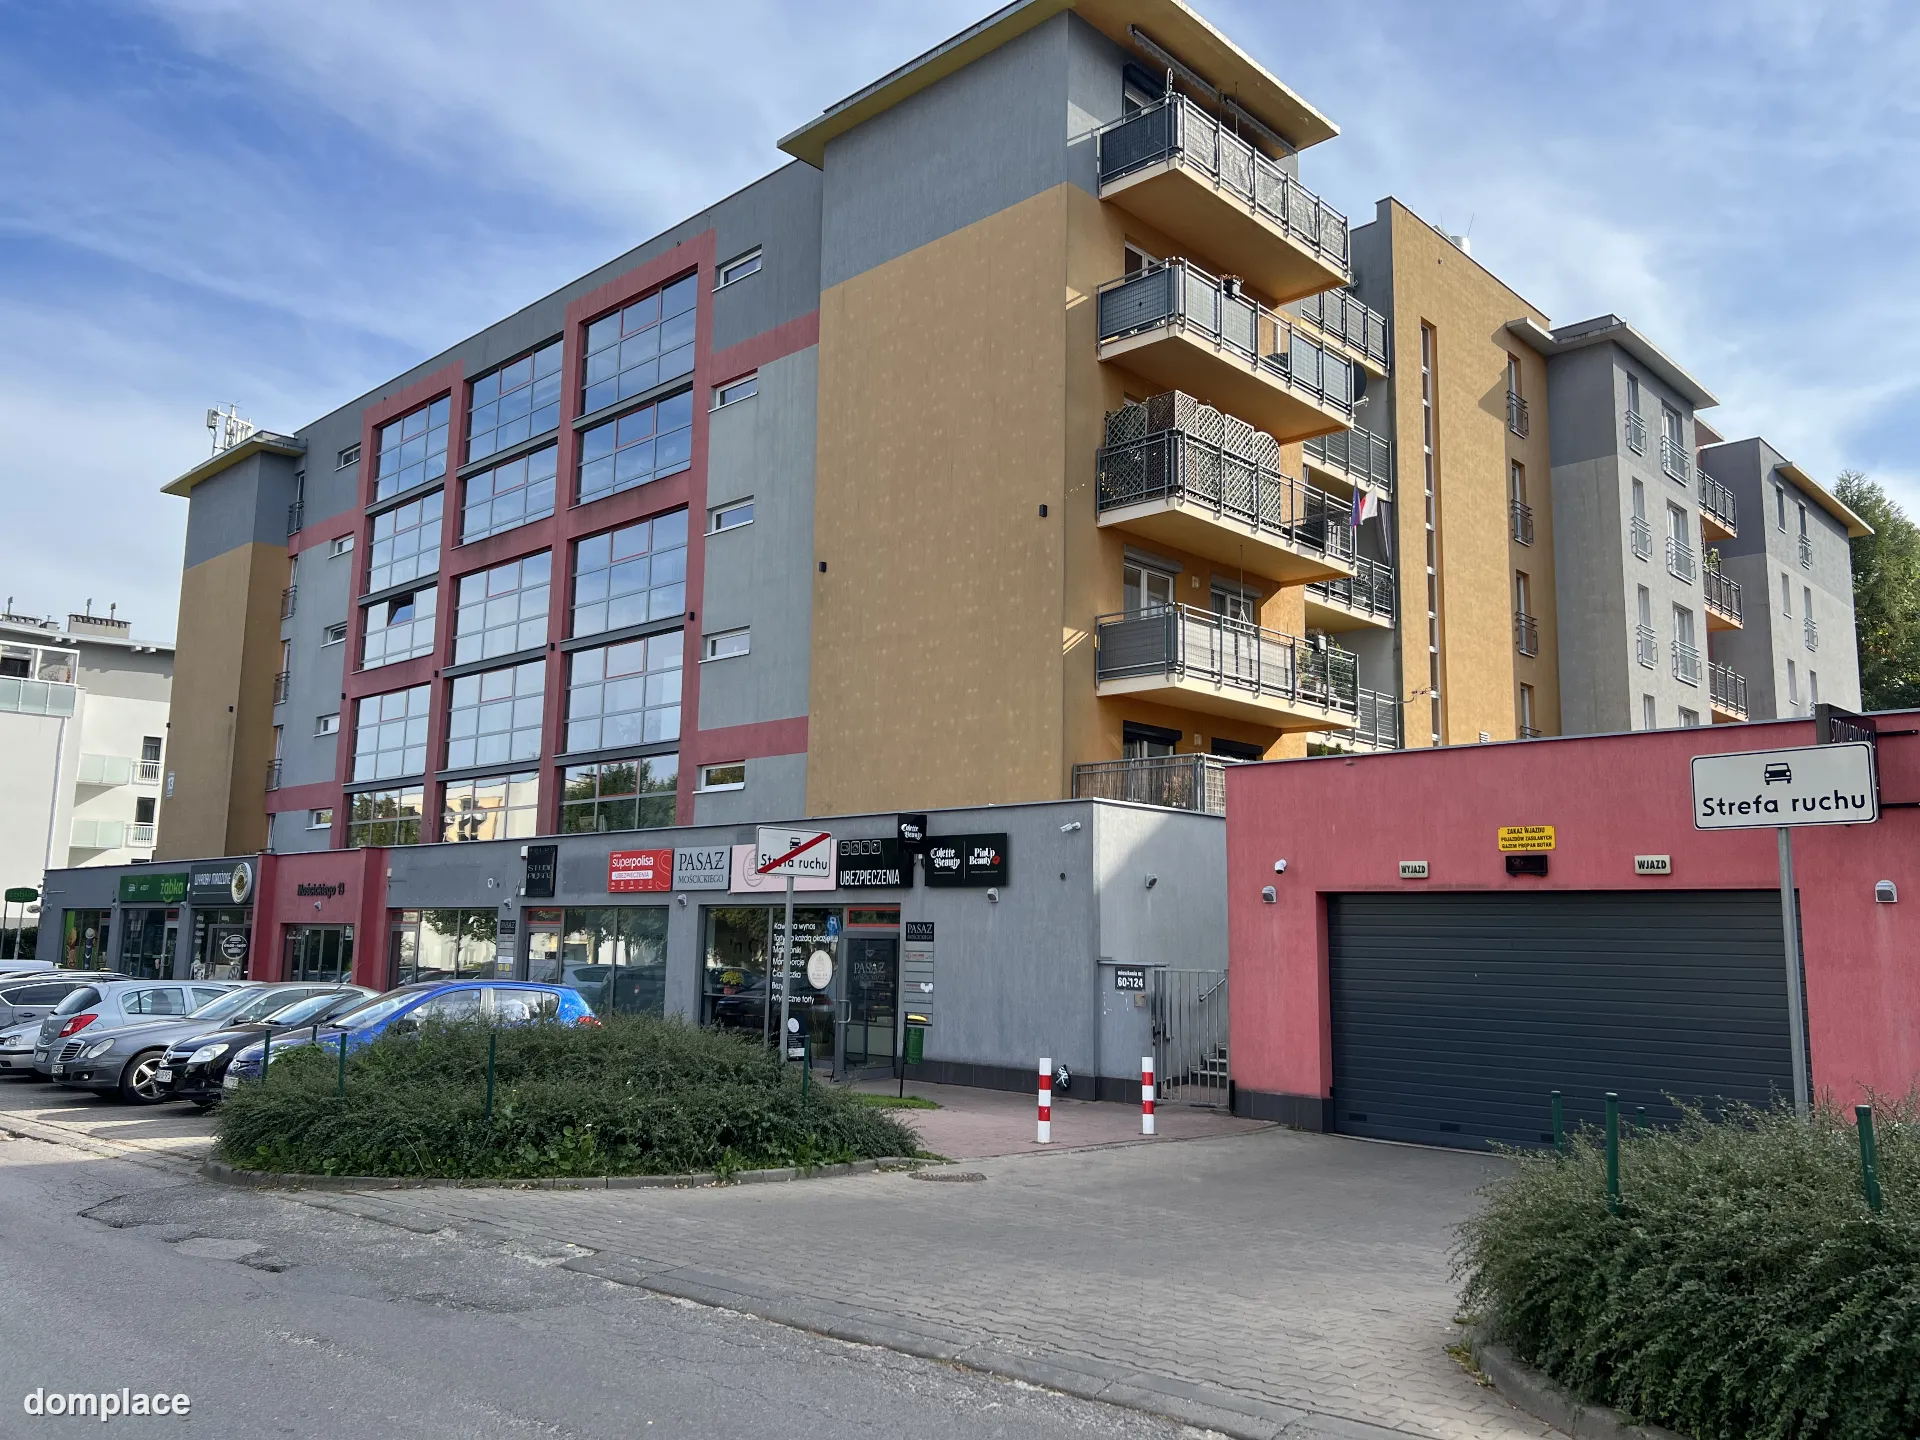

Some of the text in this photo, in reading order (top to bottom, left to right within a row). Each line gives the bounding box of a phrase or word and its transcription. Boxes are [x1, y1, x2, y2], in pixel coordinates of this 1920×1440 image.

[1702, 789, 1866, 817] Strefa ruchu
[1524, 826, 1545, 834] WJAZDU
[930, 847, 956, 859] Colette
[974, 847, 996, 859] PinUp
[612, 855, 654, 869] superpolisa
[798, 857, 828, 870] ruchu
[934, 858, 961, 870] Beauty
[969, 855, 992, 866] Beauty
[1637, 859, 1667, 870] WJAZD
[1400, 864, 1426, 874] WYJAZD
[677, 873, 724, 884] MOŚCICKIEGO
[840, 869, 900, 886] UBEZPIECZENIA
[773, 922, 786, 930] Kaw
[798, 923, 816, 931] wynos
[1117, 977, 1143, 988] 60-124
[802, 995, 815, 1004] torty
